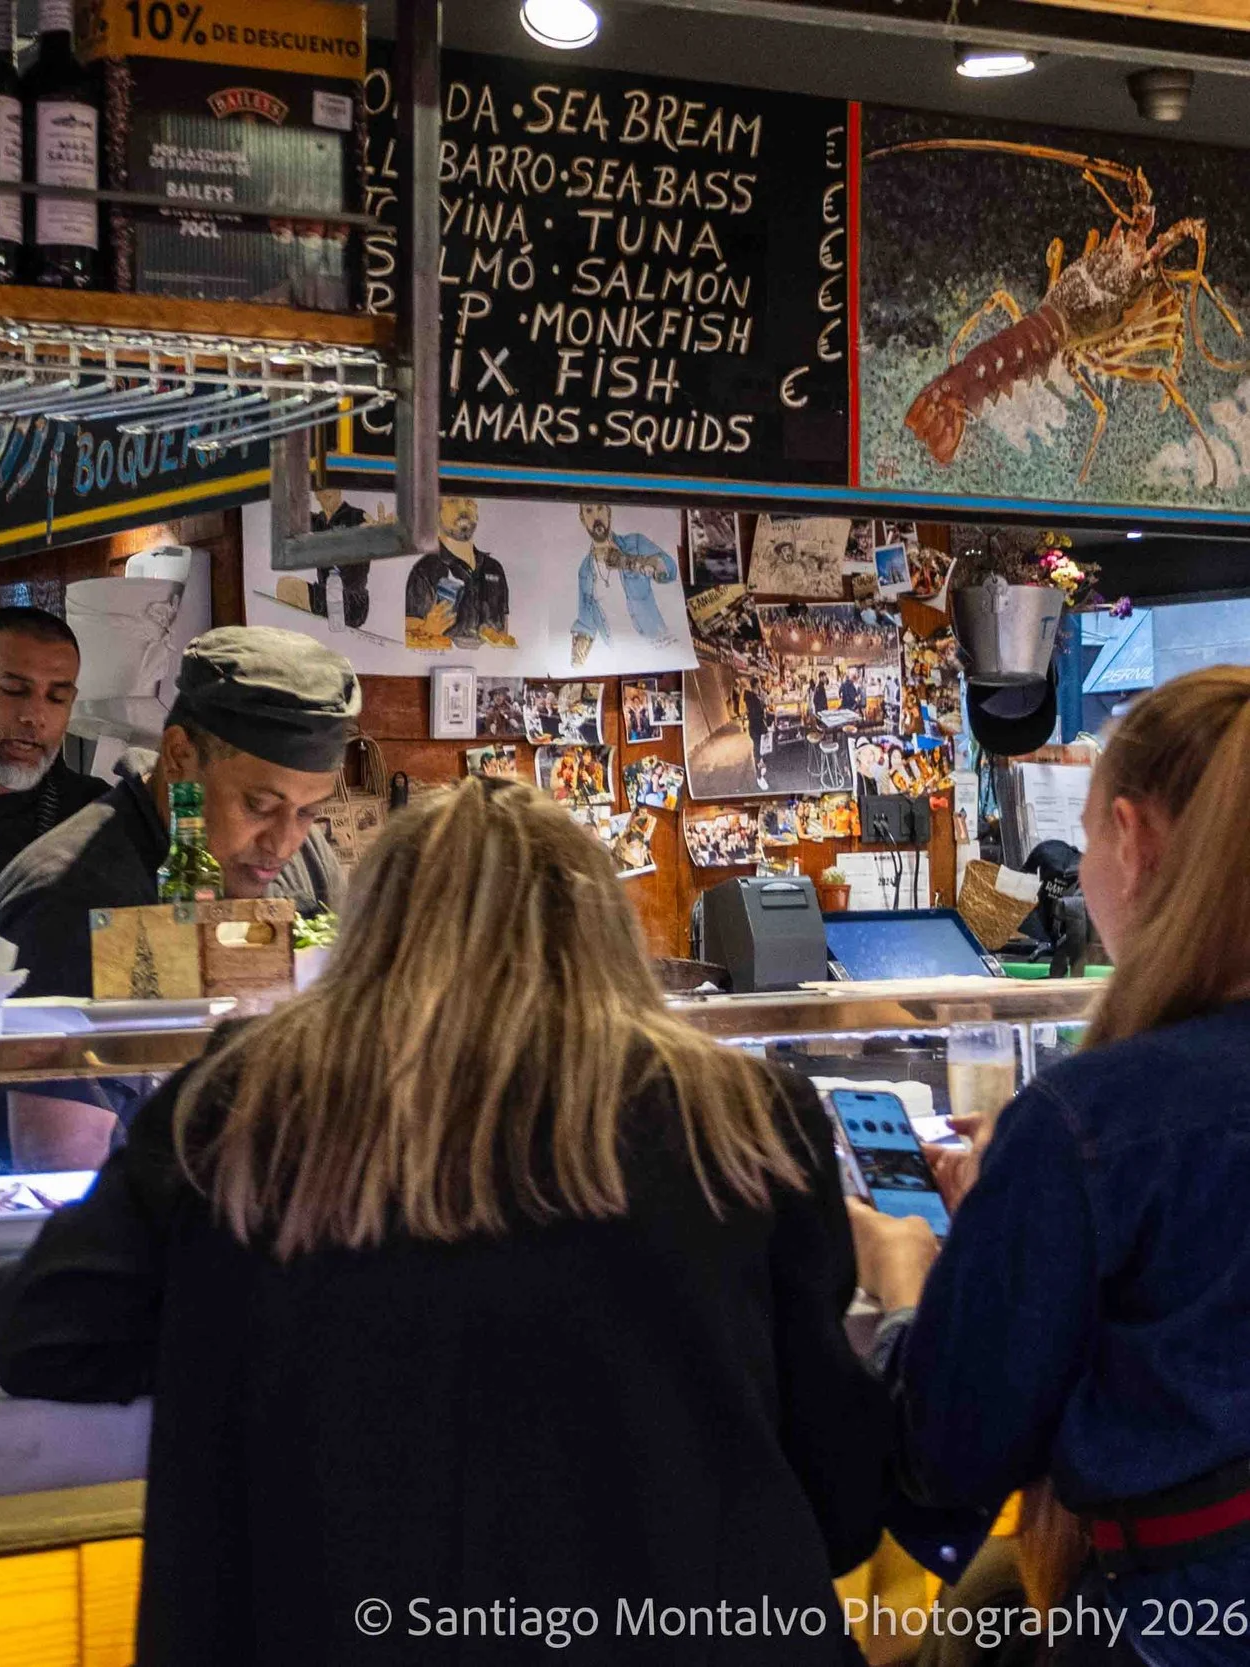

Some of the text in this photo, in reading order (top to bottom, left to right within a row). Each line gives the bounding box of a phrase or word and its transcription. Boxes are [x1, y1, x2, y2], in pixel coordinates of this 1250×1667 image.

[126, 0, 361, 58] 10% DE DESCUENTO
[525, 84, 609, 142] SEA
[619, 90, 762, 158] BREAM
[166, 181, 235, 202] BAILEYS
[565, 156, 641, 204] SEA
[646, 166, 756, 214] BASS
[578, 208, 724, 261] TUNA
[572, 258, 751, 308] SALMÓN
[779, 366, 810, 408] €
